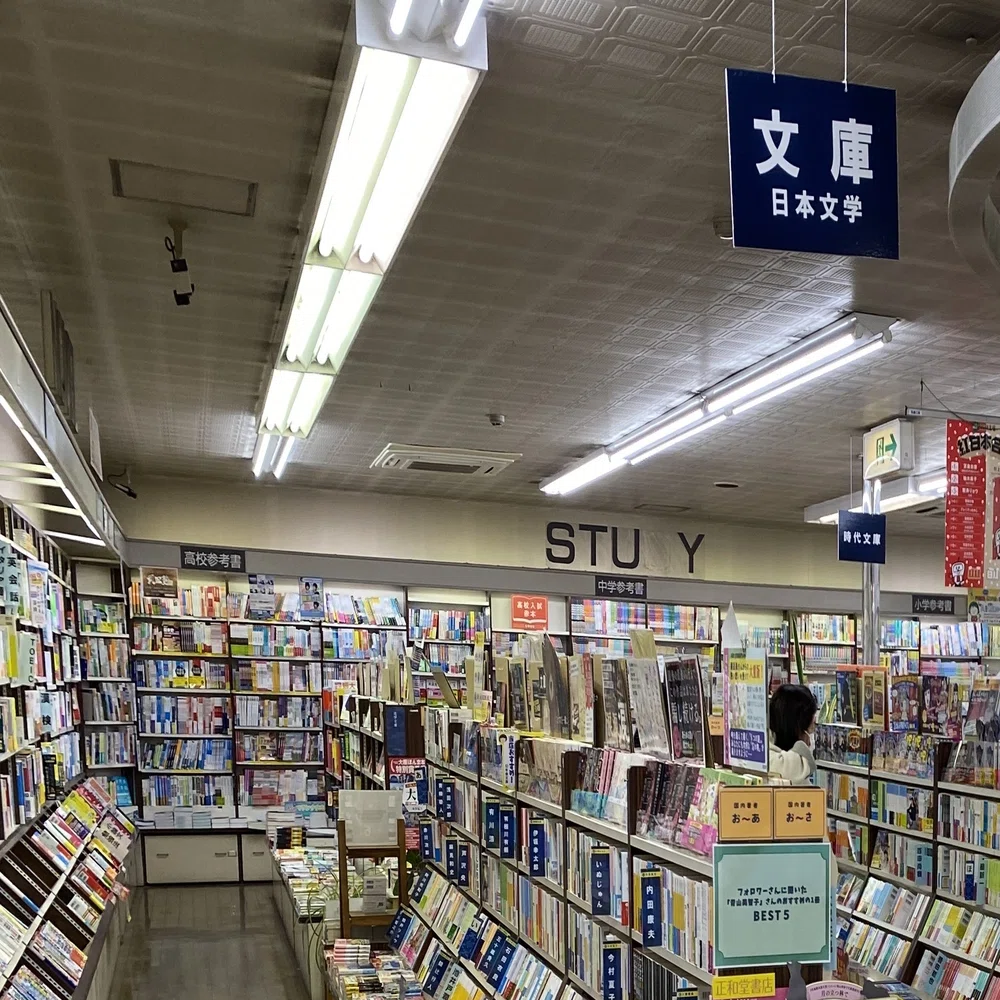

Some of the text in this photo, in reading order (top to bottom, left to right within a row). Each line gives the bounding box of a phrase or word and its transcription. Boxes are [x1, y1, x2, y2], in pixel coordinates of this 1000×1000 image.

[753, 109, 874, 185] 文庫
[771, 188, 863, 224] 日本文学
[843, 530, 882, 546] 時代文庫
[184, 551, 242, 569] 高校参考書
[7, 557, 19, 603] 英会話
[598, 580, 644, 595] 中学参考書
[913, 598, 953, 614] 小学参考書
[737, 885, 807, 896] フォロワーさんに聞いた
[646, 885, 655, 939] 内田康夫
[753, 909, 790, 921] BEST 5
[715, 976, 774, 996] 正和堂書店
